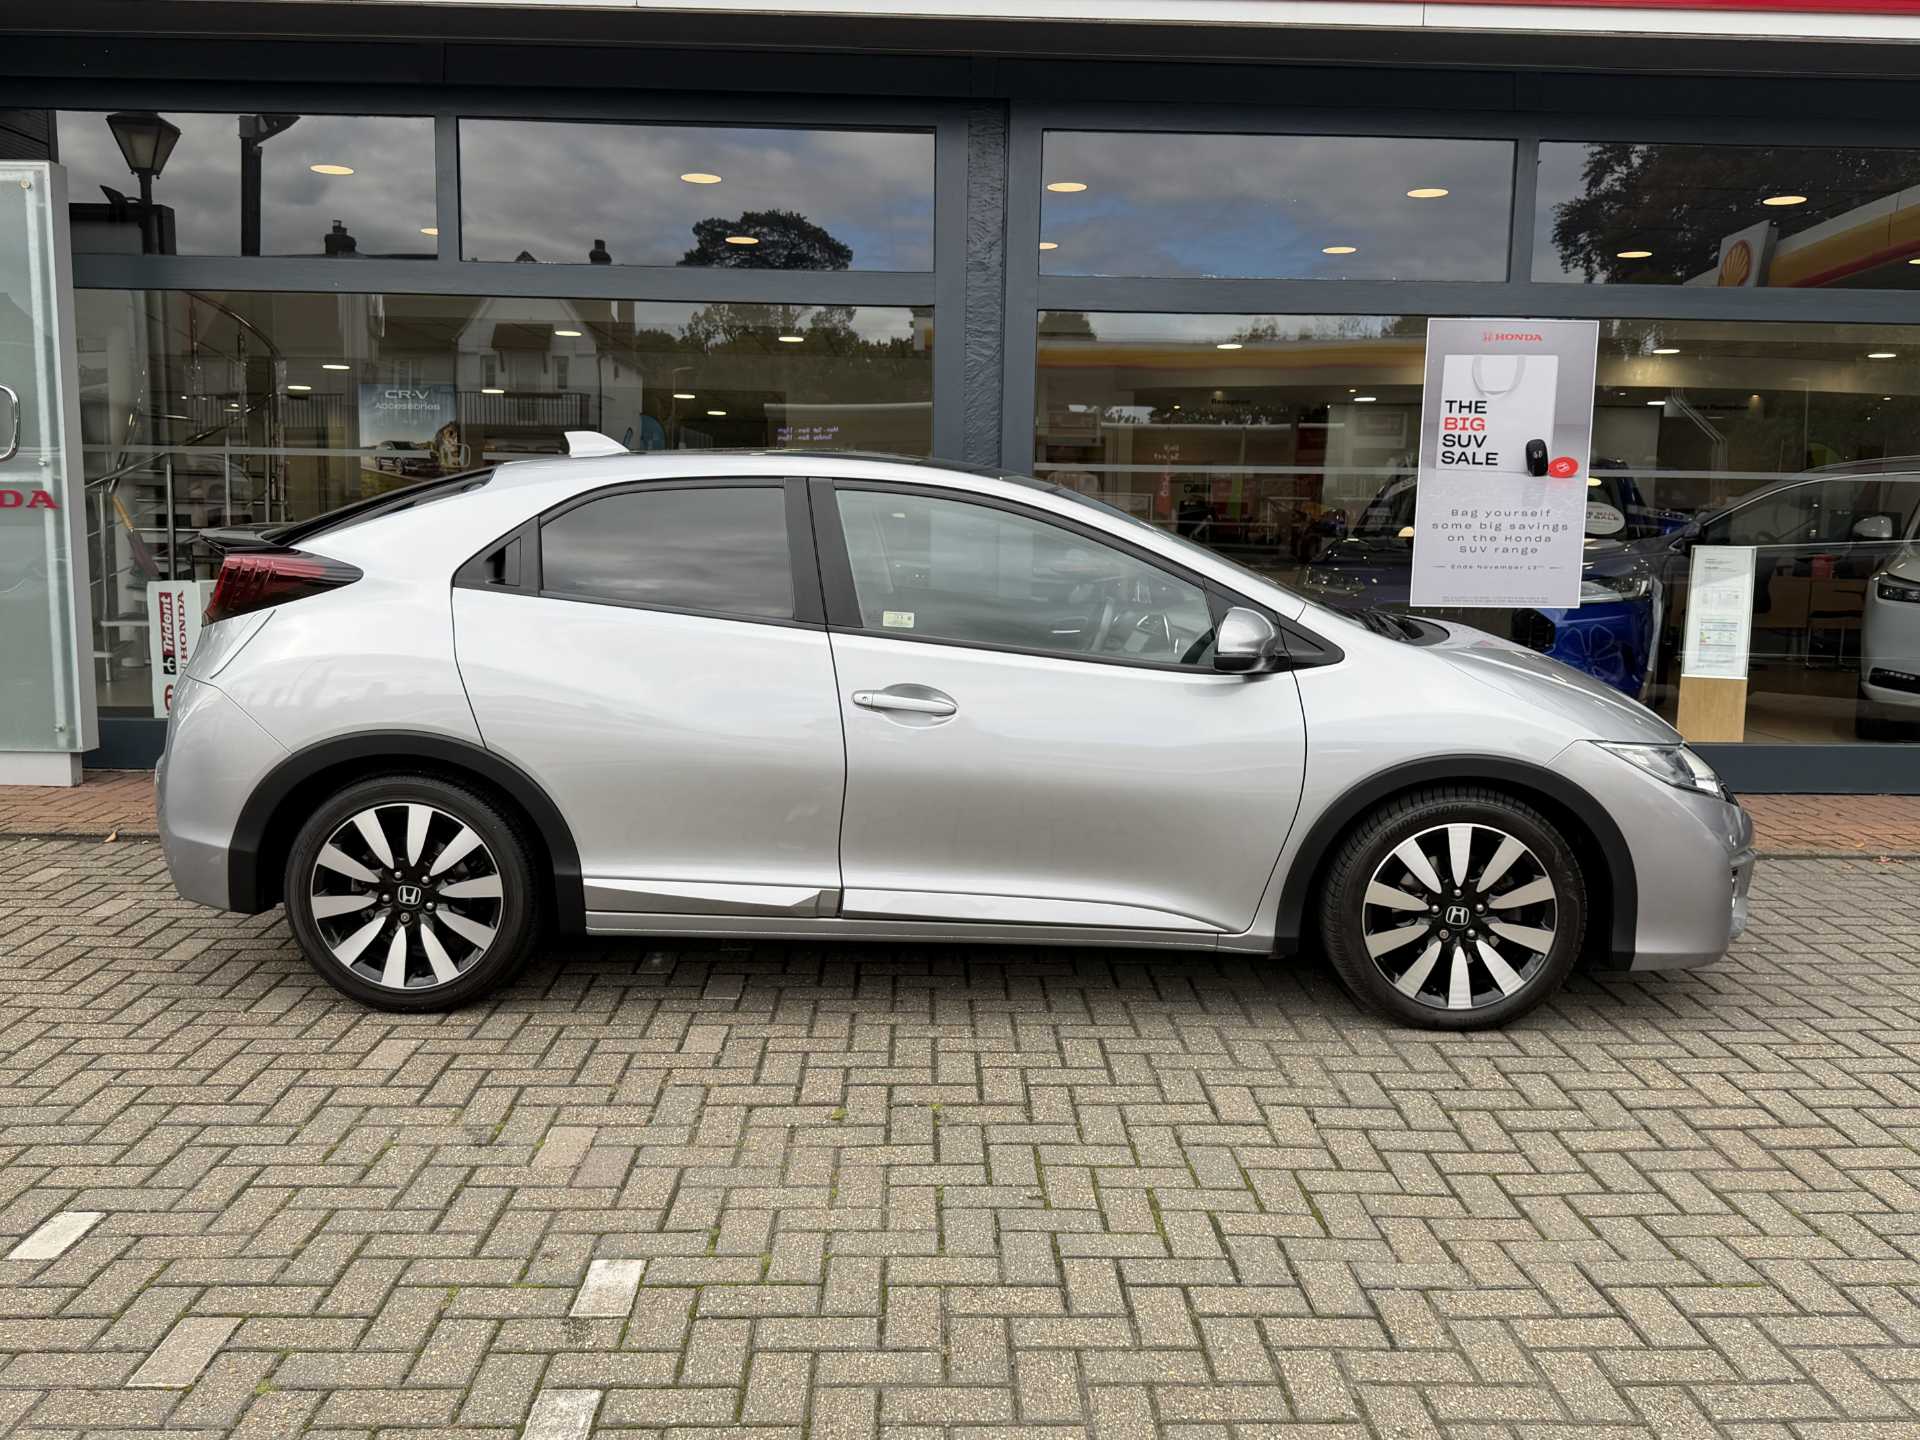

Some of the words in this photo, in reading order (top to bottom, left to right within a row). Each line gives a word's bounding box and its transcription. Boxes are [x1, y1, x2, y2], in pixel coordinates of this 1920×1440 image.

[1495, 333, 1543, 342] HONDA
[385, 390, 429, 399] CR-V
[1445, 400, 1487, 414] THE
[1444, 416, 1486, 432] BIG
[1442, 433, 1488, 448] SUV
[1441, 450, 1499, 466] SALE
[1451, 509, 1479, 519] Bag
[1484, 508, 1551, 519] yourself
[1432, 522, 1472, 530] some
[1479, 521, 1503, 532] big
[1509, 522, 1569, 533] savings
[1447, 534, 1465, 542] on
[1472, 534, 1497, 543] the
[1504, 534, 1552, 543] Honda
[1459, 545, 1488, 554] SUV
[1494, 546, 1539, 556] range
[161, 594, 175, 653] Trident
[177, 590, 189, 661] HONDA
